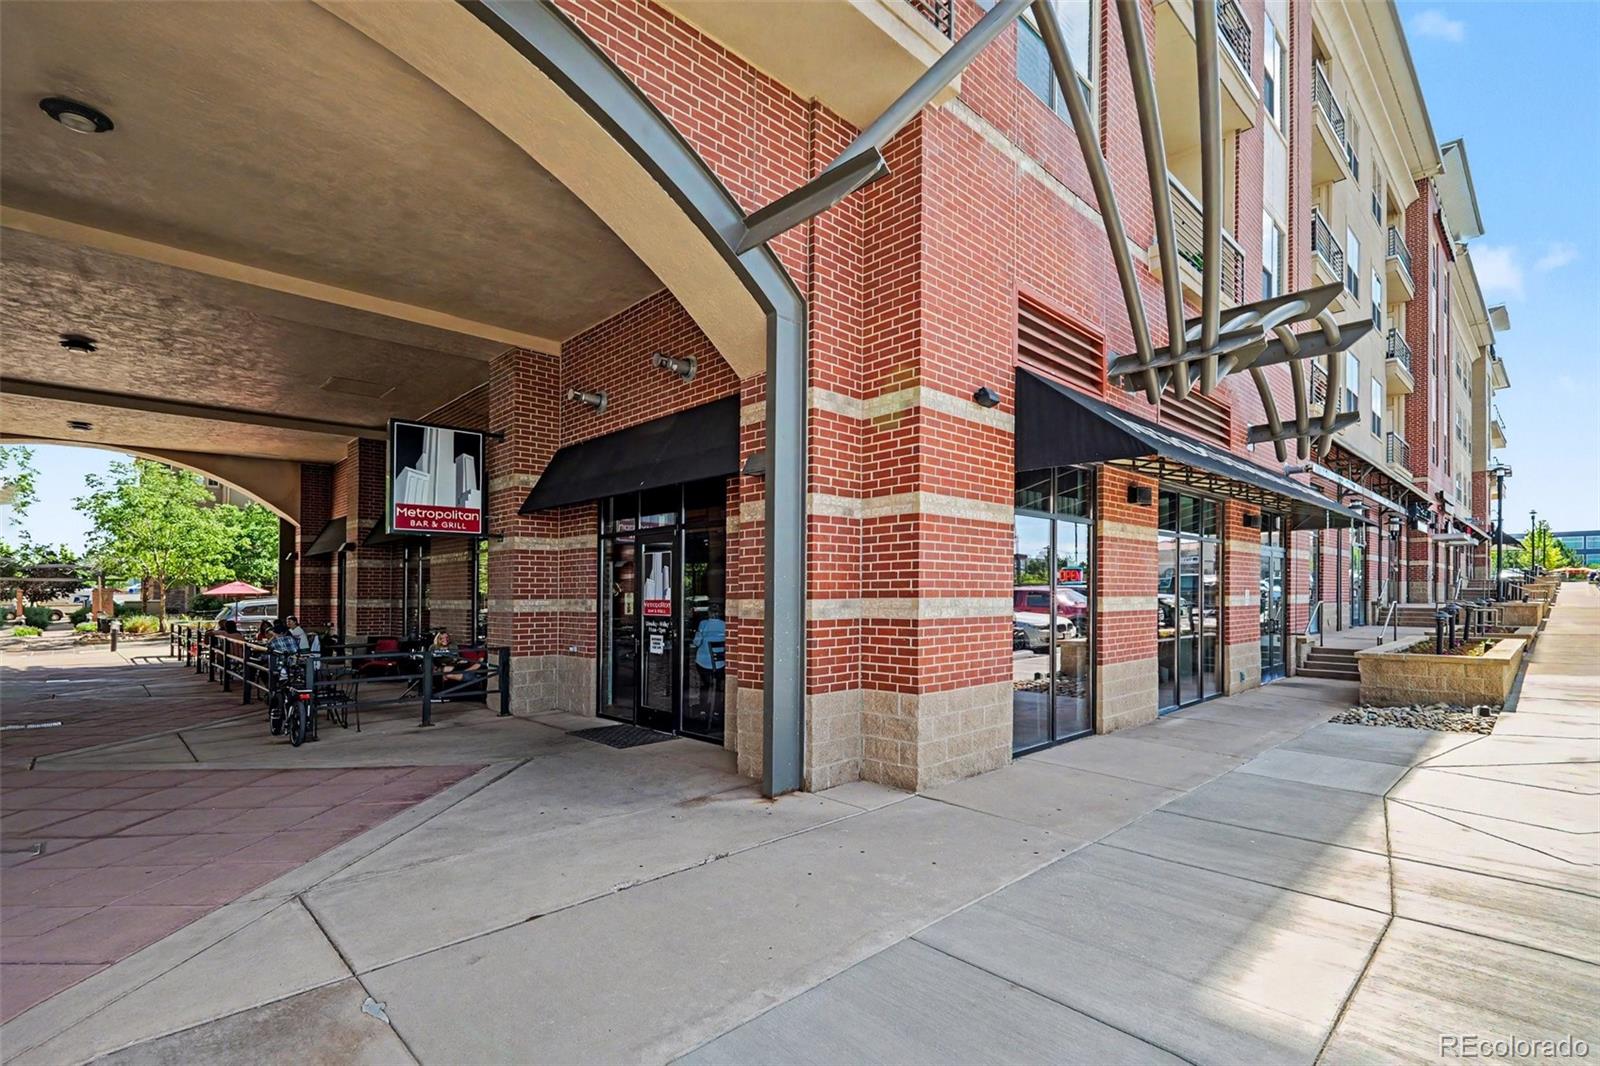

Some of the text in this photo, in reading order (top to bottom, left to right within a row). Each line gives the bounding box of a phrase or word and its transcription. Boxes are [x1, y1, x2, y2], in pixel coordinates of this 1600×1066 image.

[396, 507, 479, 521] Metropolitan
[410, 520, 429, 528] BAR
[441, 521, 467, 530] GRILL
[1059, 570, 1081, 581] OPEN
